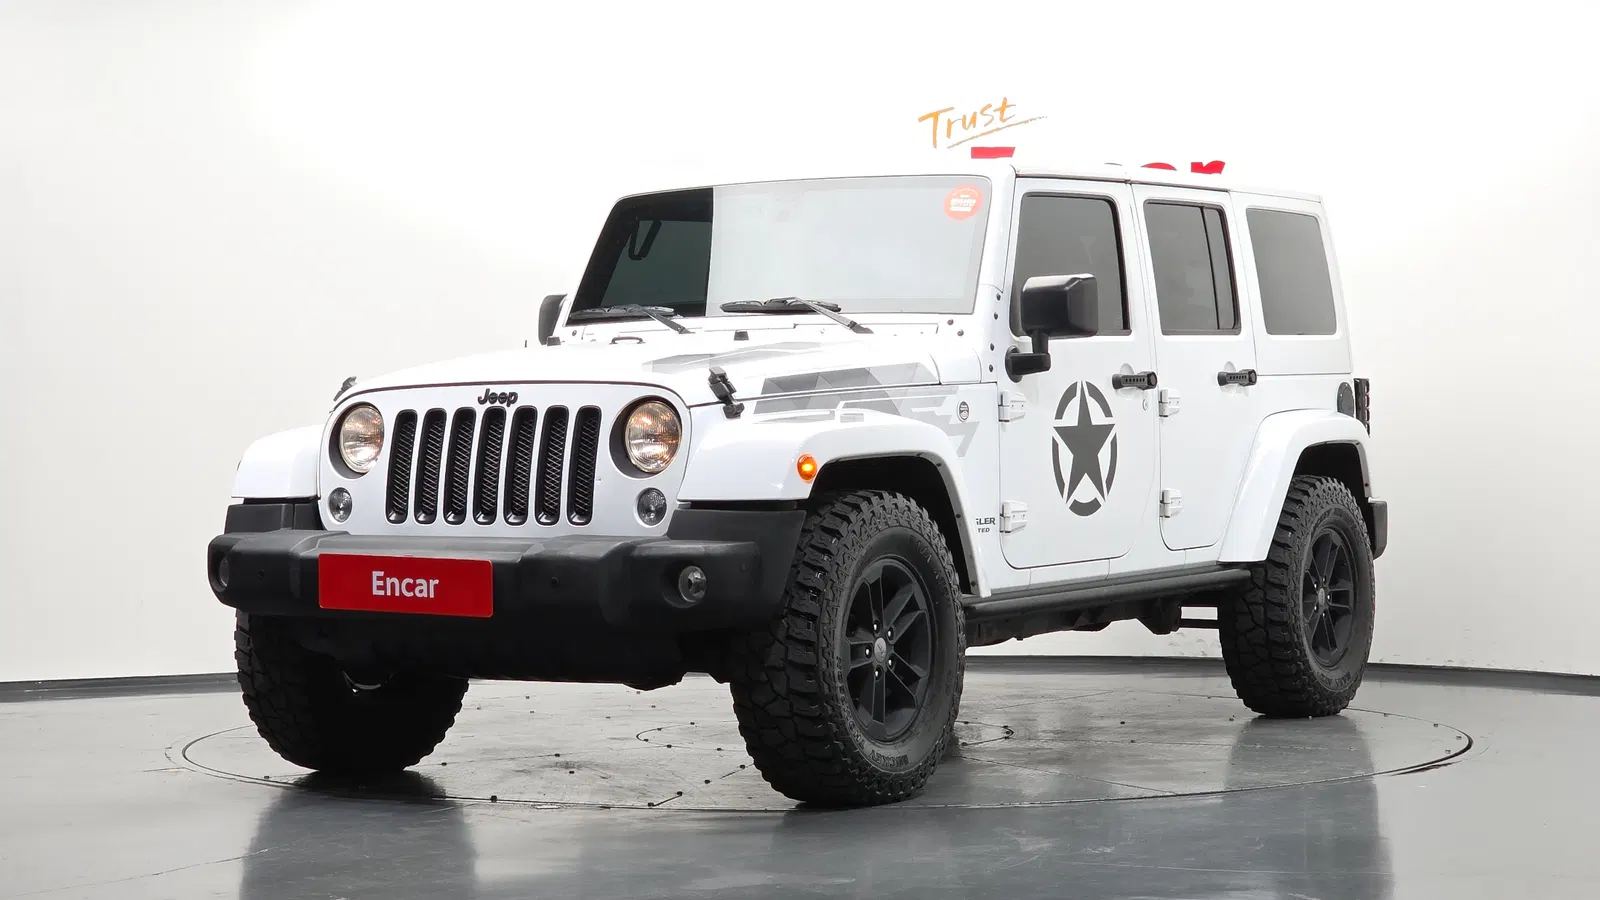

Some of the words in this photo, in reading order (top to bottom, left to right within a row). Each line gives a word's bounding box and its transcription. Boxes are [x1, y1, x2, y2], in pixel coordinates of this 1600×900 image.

[918, 96, 1016, 149] Trust
[477, 388, 518, 408] Jeep
[371, 570, 439, 599] Encar
